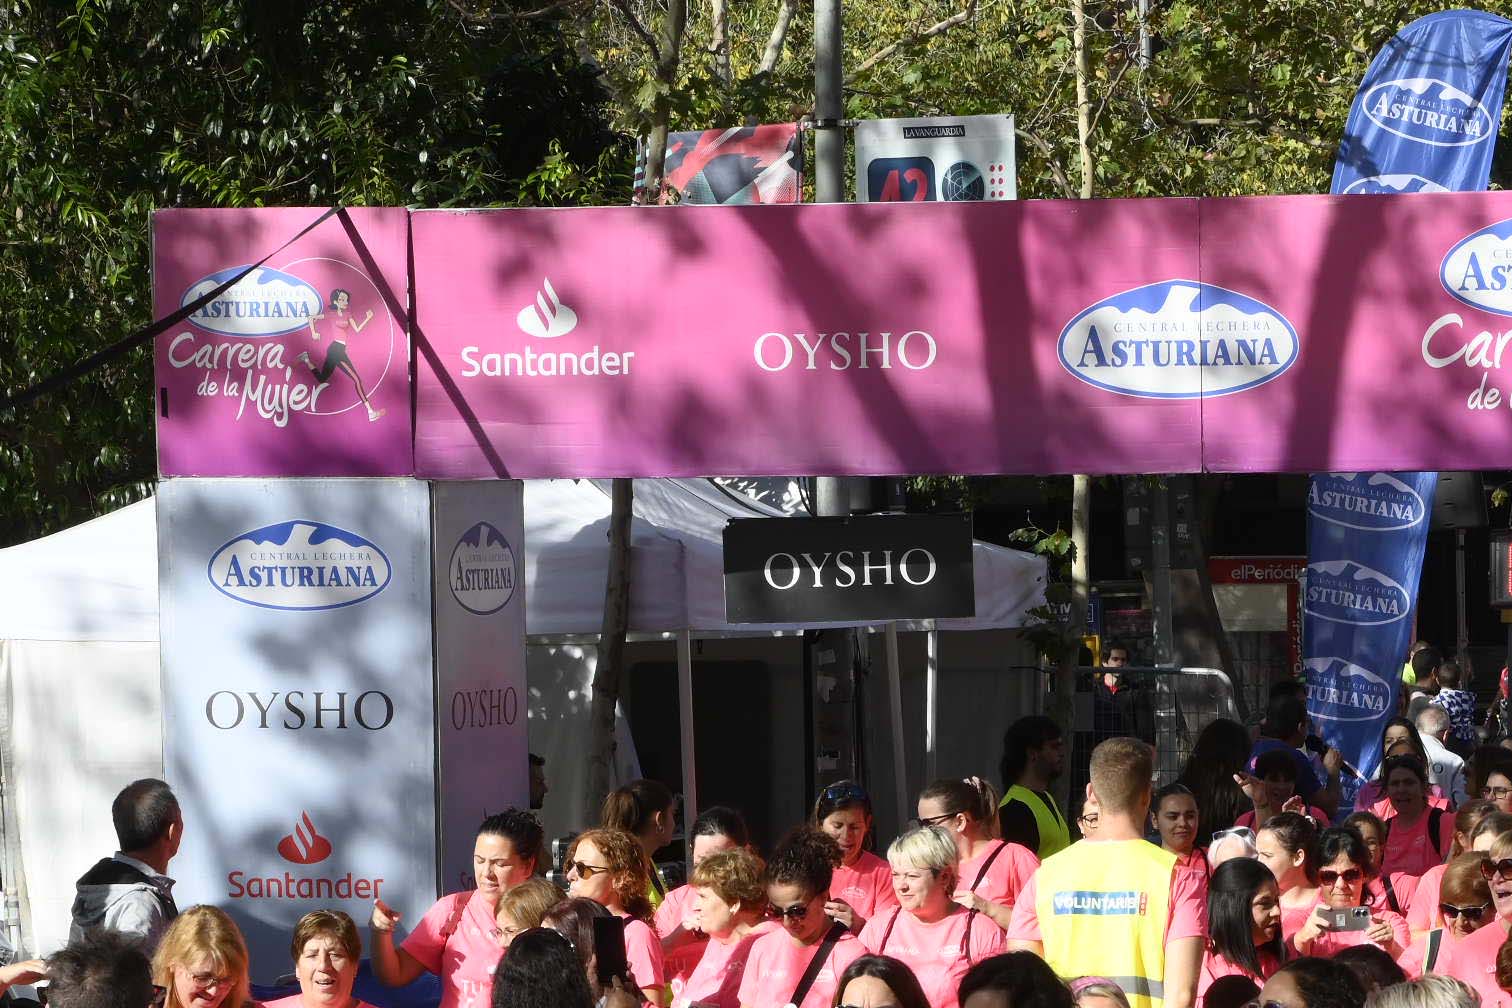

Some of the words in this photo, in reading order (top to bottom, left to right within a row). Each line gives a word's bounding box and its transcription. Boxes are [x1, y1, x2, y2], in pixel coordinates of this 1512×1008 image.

[1371, 92, 1481, 137] ASTURIANA
[190, 291, 312, 320] ASTURIANA
[1076, 324, 1280, 369] ASTURIANA
[1113, 321, 1188, 335] CENTRAL
[1196, 320, 1272, 333] LECHERA
[168, 331, 284, 370] Carrera
[461, 345, 634, 378] Santander
[753, 331, 937, 373] OYSHO
[197, 371, 218, 397] de
[223, 374, 239, 398] la
[236, 366, 330, 428] Mujer
[1467, 371, 1502, 411] de
[1308, 480, 1414, 522] ASTURIANA
[223, 554, 378, 588] ASTURIANA
[250, 551, 310, 562] CENTRAL
[312, 551, 373, 562] LECHERA
[454, 556, 512, 592] ASTURIANA
[764, 548, 937, 590] OYSHO
[1307, 585, 1399, 615] STURIANA
[206, 690, 394, 731] OYSHO
[451, 686, 518, 730] OYSHO
[1306, 684, 1384, 711] TURIANA
[228, 871, 384, 899] Santander
